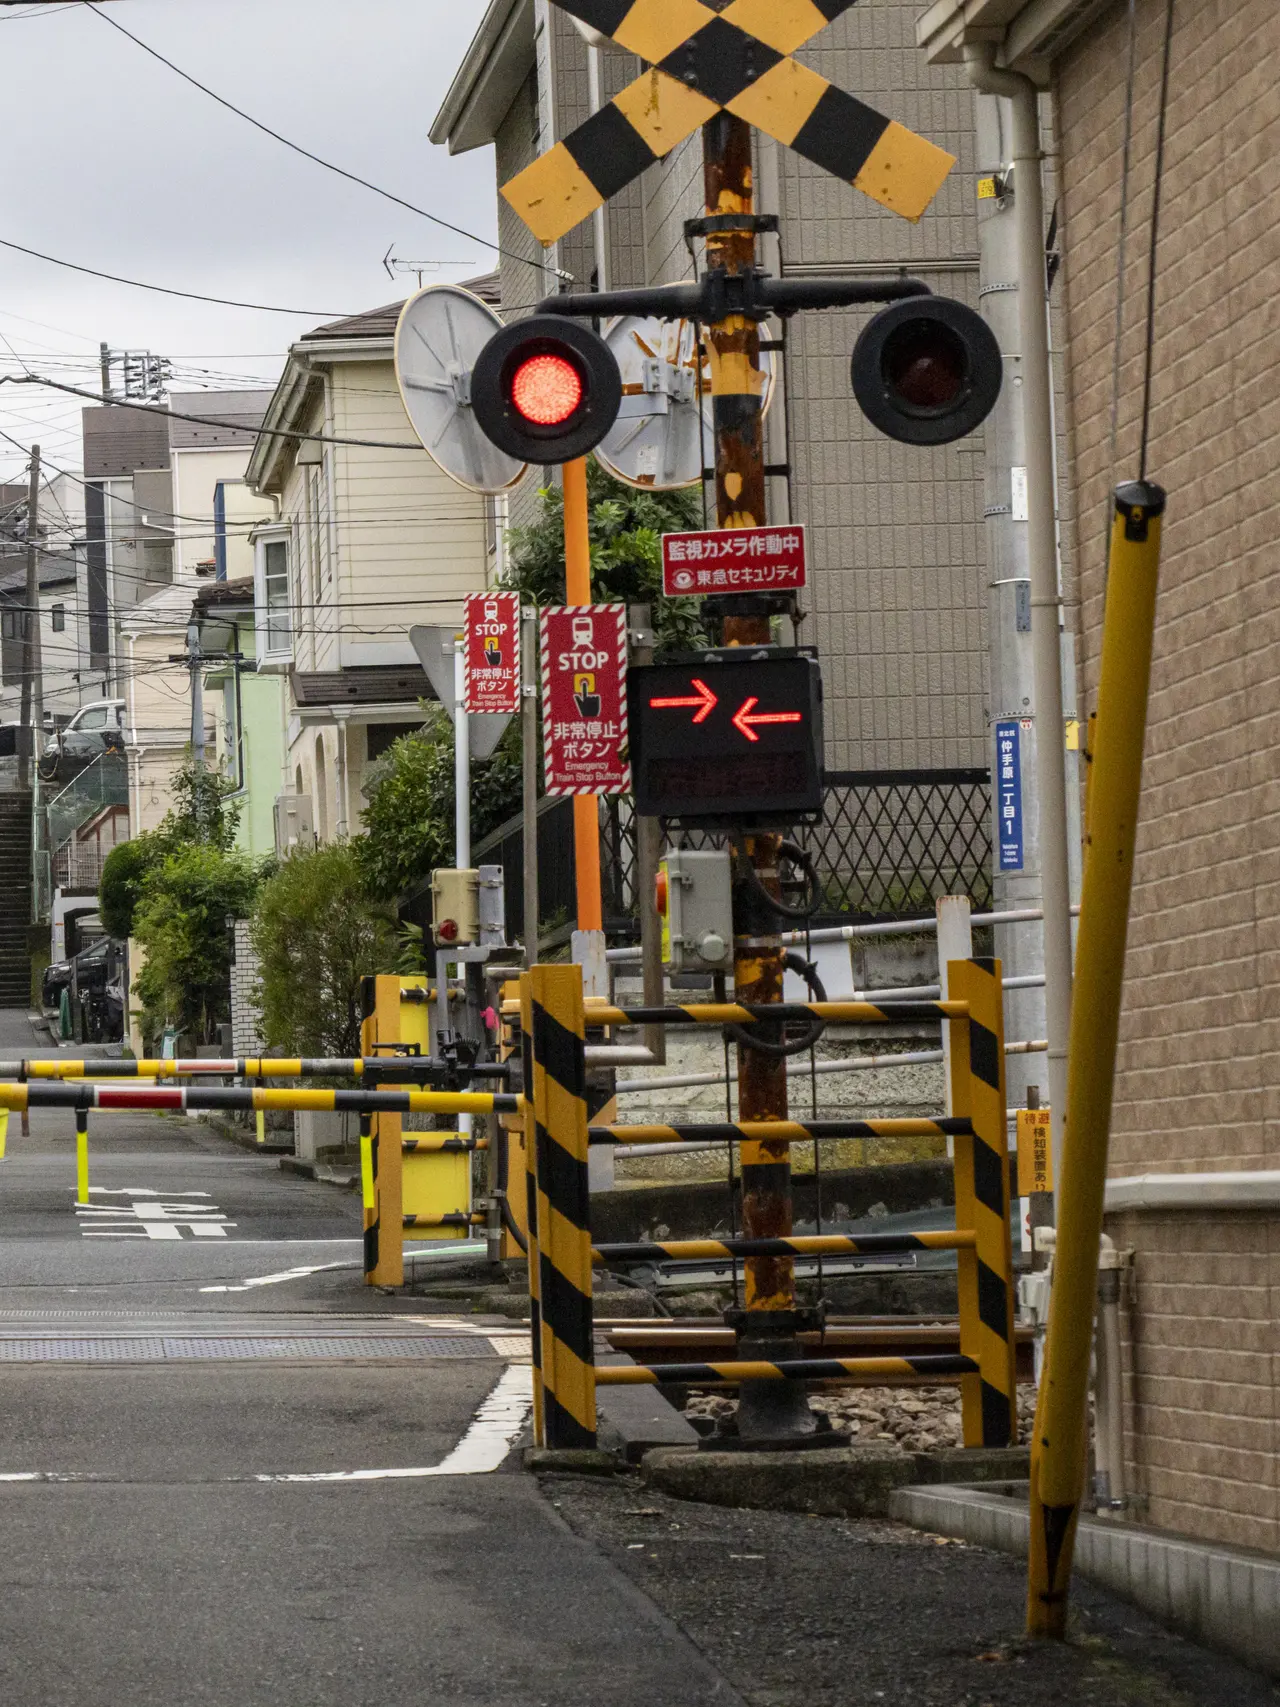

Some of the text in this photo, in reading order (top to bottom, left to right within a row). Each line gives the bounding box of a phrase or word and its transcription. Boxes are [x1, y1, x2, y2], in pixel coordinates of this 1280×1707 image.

[668, 534, 799, 561] 監視カメラ作動中
[697, 565, 799, 586] 東急セキュリティ
[475, 624, 508, 636] STOP
[558, 652, 609, 671] STOP
[471, 668, 513, 680] 非常停止
[477, 681, 507, 692] ボタン
[553, 720, 619, 740] 非常停止
[563, 742, 611, 758] ボタン
[565, 761, 609, 772] Emergency
[555, 771, 621, 782] Train Stop Button
[1001, 740, 1015, 835] 仲手原一丁目1
